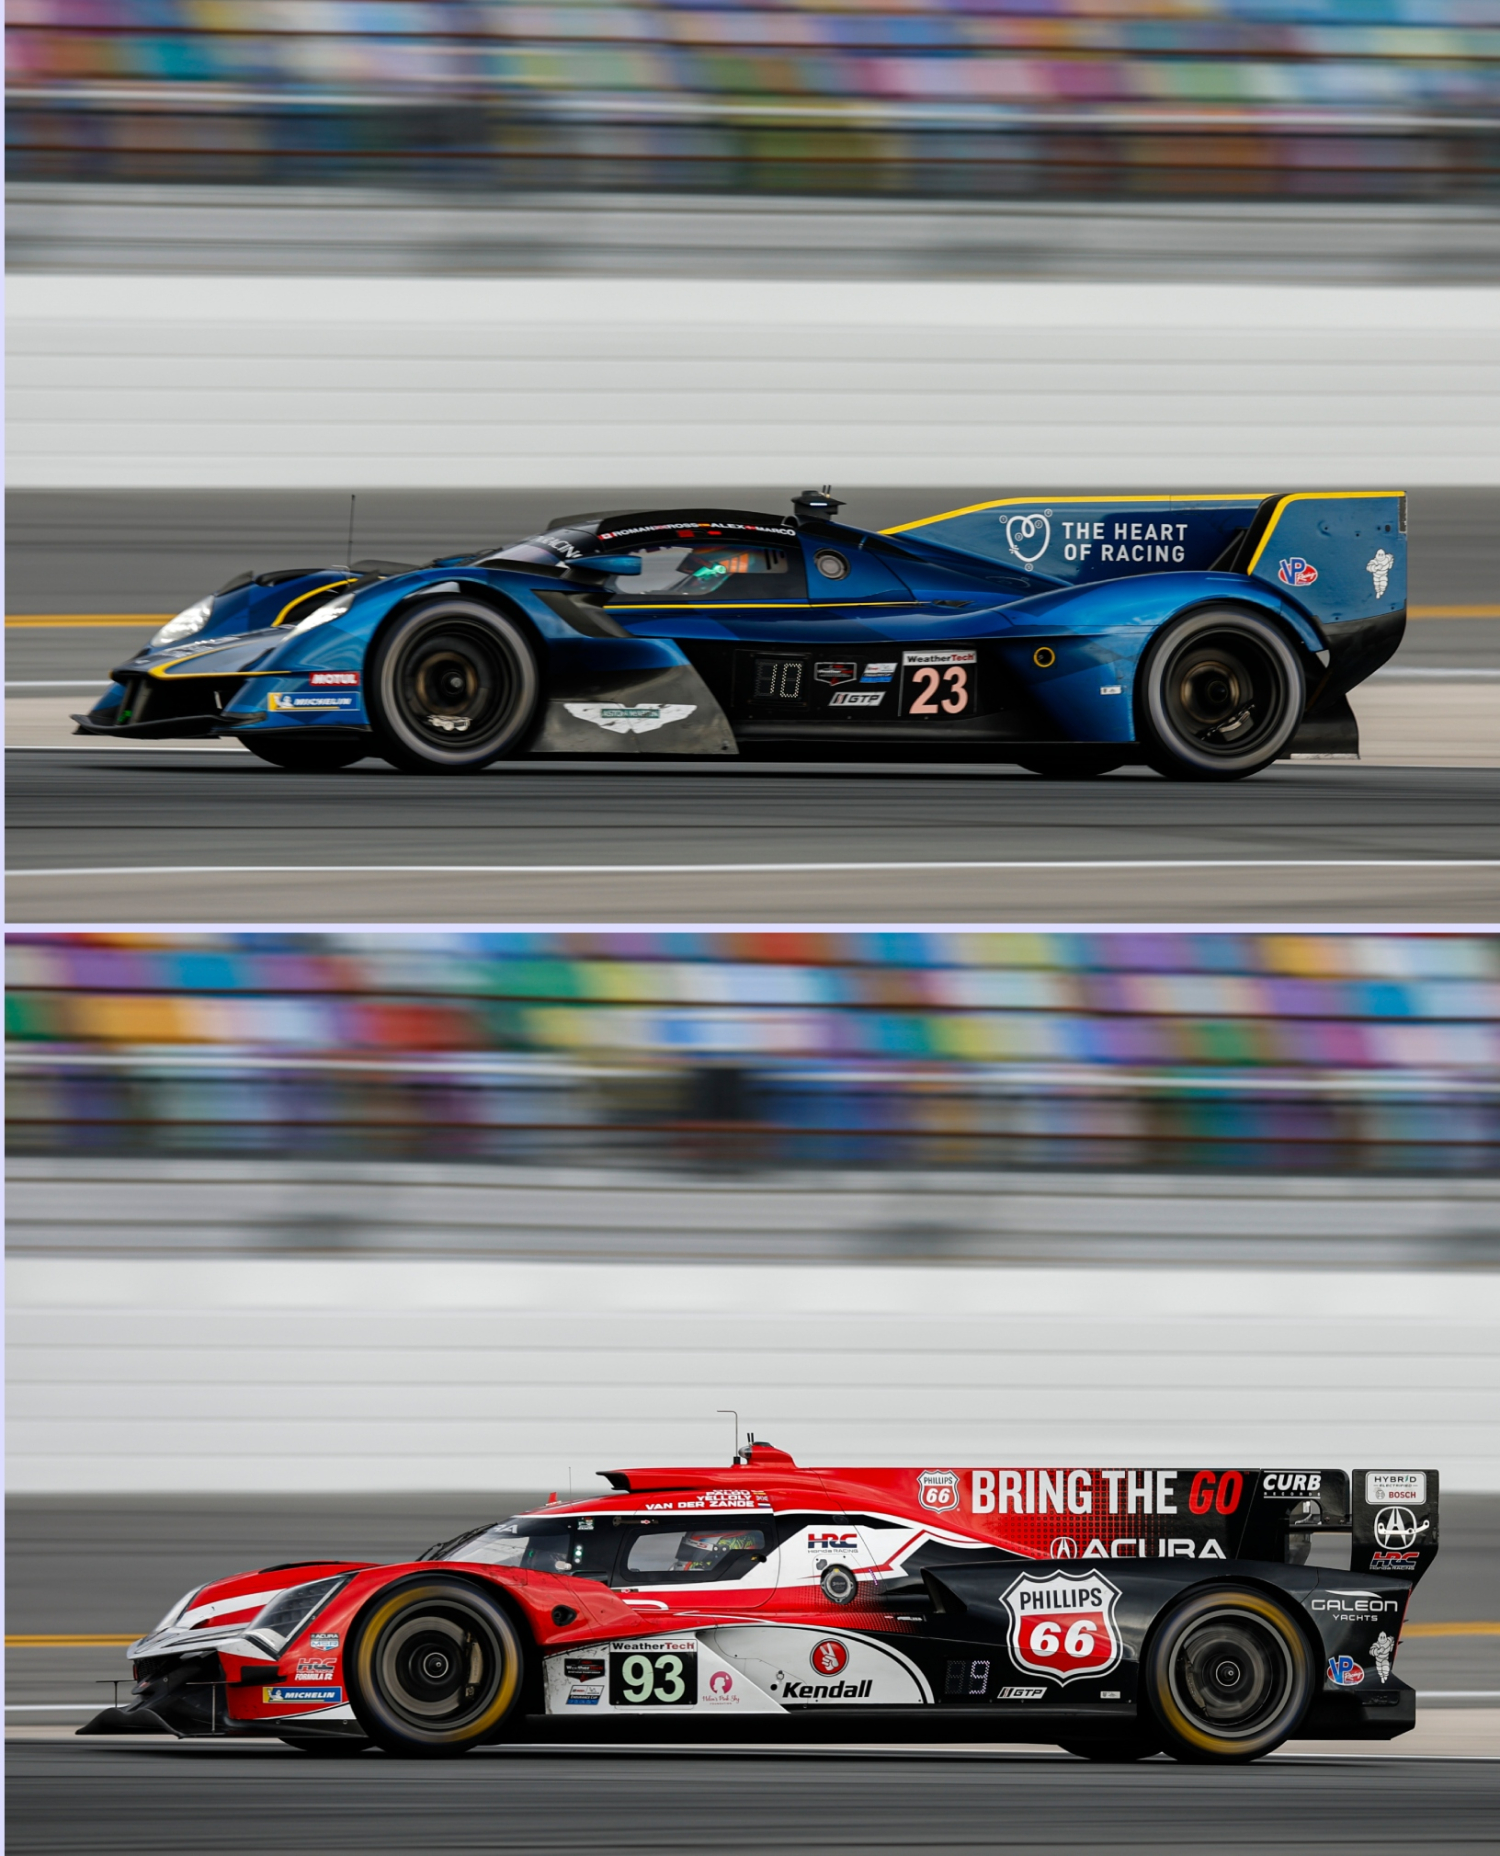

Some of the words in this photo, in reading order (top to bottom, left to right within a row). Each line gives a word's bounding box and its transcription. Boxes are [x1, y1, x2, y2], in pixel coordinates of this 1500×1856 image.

[612, 525, 654, 537] ROMAN
[668, 522, 698, 530] ROSS
[710, 522, 746, 530] ALEX
[754, 527, 797, 536] MARCO
[1062, 522, 1105, 540] THE
[1114, 523, 1189, 541] HEART
[1064, 543, 1093, 561] OF
[1101, 544, 1186, 563] RACING
[1280, 557, 1306, 585] VP
[907, 653, 975, 663] WeatherTech
[311, 673, 358, 684] MOTUL
[769, 663, 803, 698] 10
[908, 666, 969, 715] 23
[293, 697, 352, 706] MICHELIN
[847, 694, 881, 703] GTP
[923, 1476, 953, 1485] PHILLIPS
[1263, 1473, 1322, 1491] CURB
[1374, 1475, 1417, 1483] HYBRID
[925, 1488, 951, 1504] 66
[971, 1469, 1093, 1515] BRING
[1101, 1470, 1178, 1514] THE
[1188, 1470, 1244, 1515] GO
[1388, 1491, 1417, 1499] BOSCH
[709, 1500, 755, 1508] ZANDE
[808, 1533, 858, 1549] HRC
[1081, 1539, 1227, 1559] ACURA
[1370, 1551, 1420, 1566] HRC
[1019, 1587, 1103, 1611] PHILLIPS
[1311, 1599, 1398, 1613] GALEON
[1332, 1614, 1378, 1622] YACHTS
[1029, 1619, 1098, 1657] 66
[612, 1642, 695, 1651] WeatherTech
[297, 1657, 338, 1671] HRC
[1328, 1655, 1354, 1684] VP
[622, 1654, 686, 1703] 93
[782, 1679, 873, 1699] Kendall
[1013, 1689, 1043, 1697] GTP
